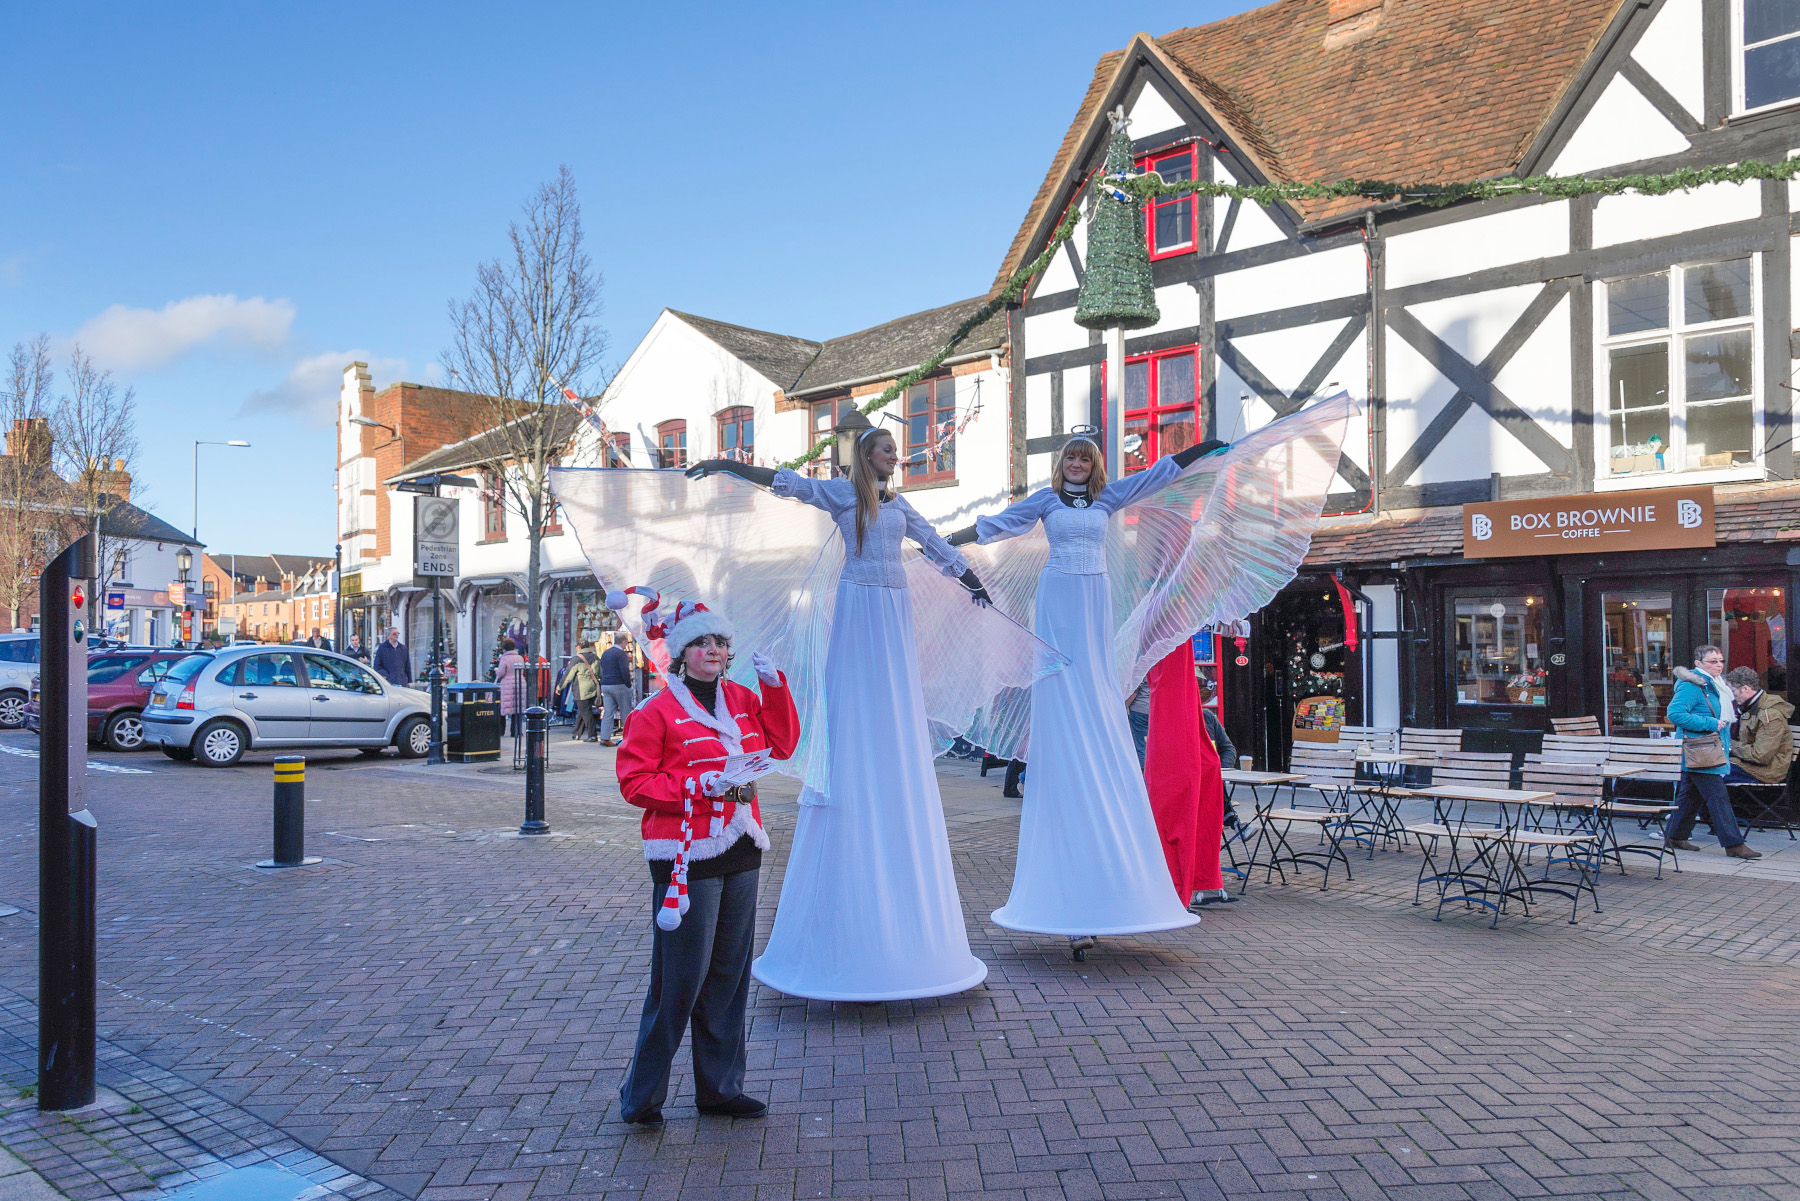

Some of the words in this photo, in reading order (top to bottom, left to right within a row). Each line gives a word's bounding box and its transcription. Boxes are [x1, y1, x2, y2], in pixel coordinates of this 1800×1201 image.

[1510, 512, 1551, 531] BOX
[1556, 505, 1656, 528] BROWNIE
[1561, 528, 1601, 539] COFFEE
[420, 544, 457, 553] Pedestrian
[423, 562, 454, 573] ENDS
[1554, 655, 1565, 663] 20
